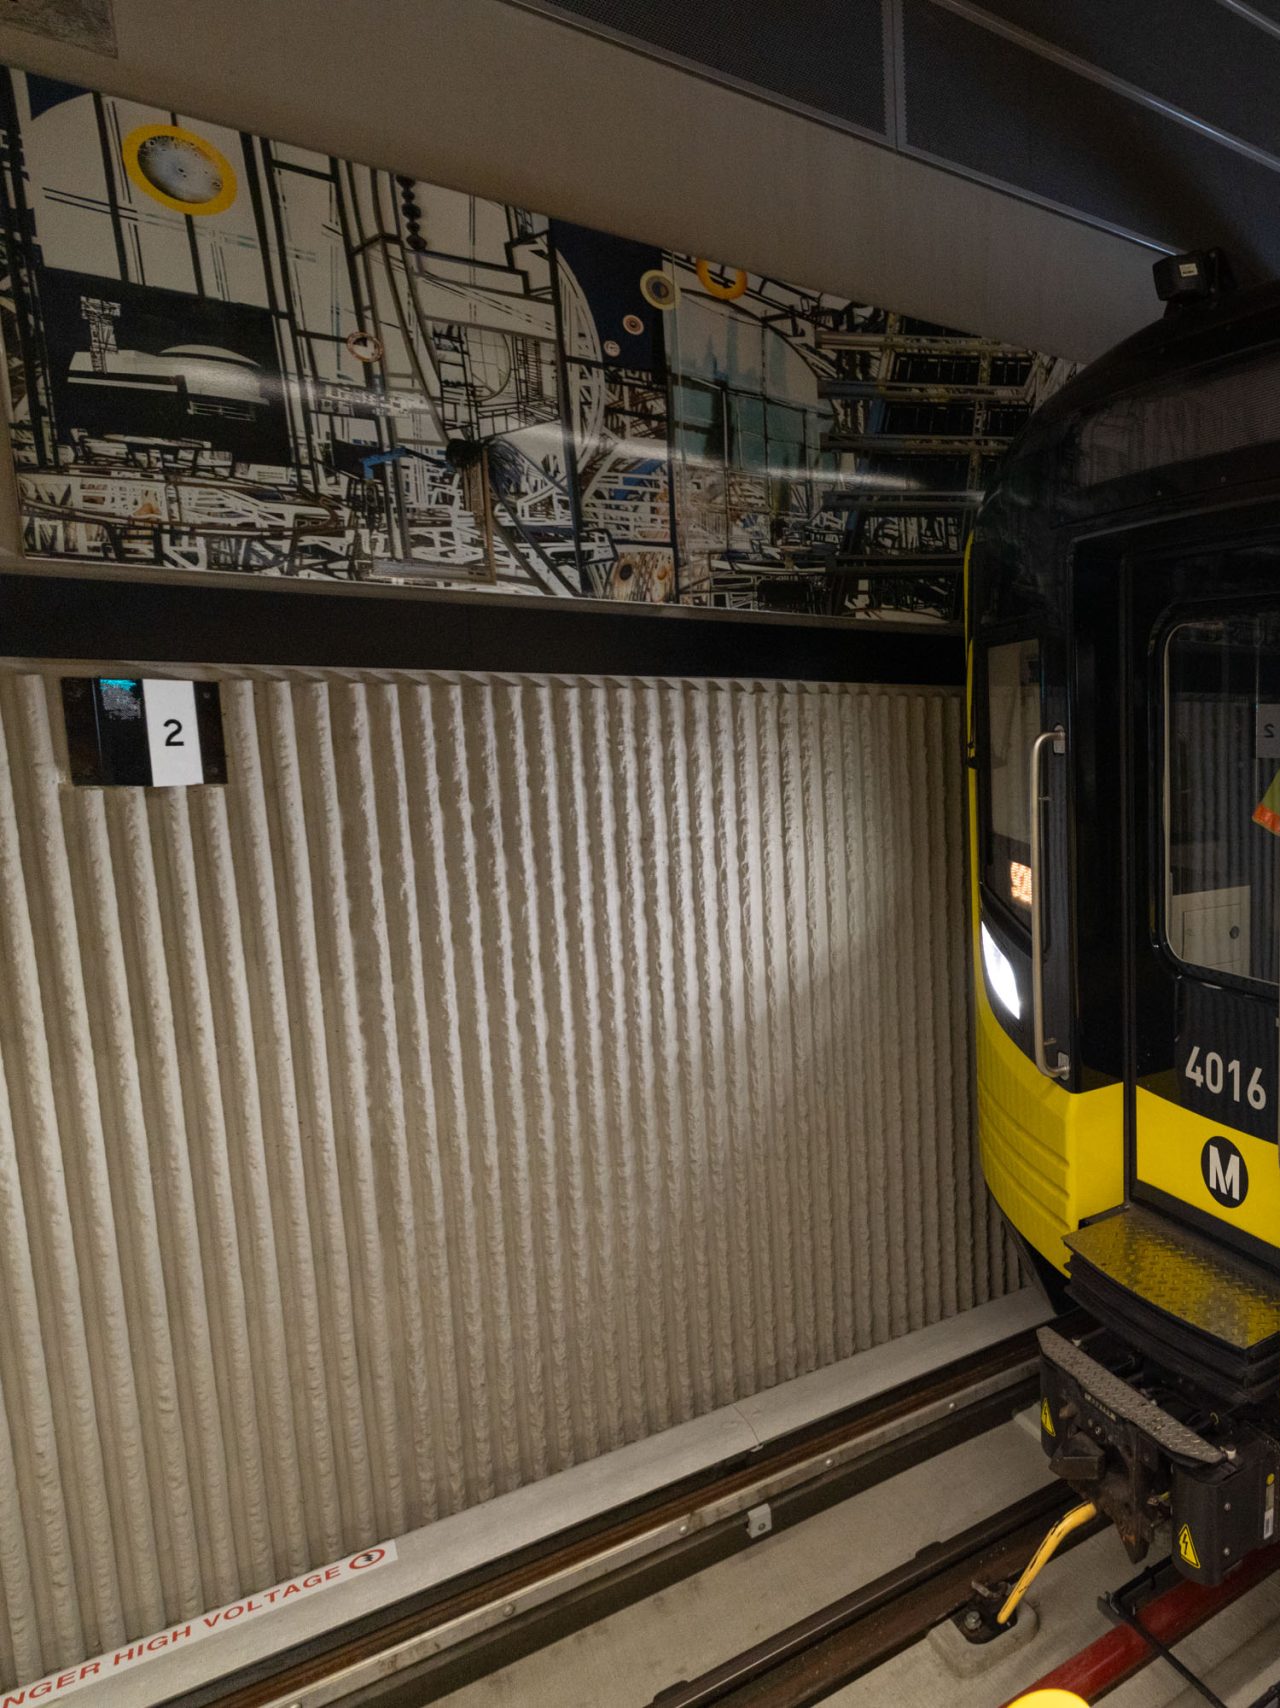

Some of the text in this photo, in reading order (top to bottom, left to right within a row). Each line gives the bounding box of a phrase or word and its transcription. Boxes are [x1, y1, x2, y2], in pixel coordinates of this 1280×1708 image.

[163, 718, 185, 747] 2
[1185, 1045, 1267, 1111] 4016
[1209, 1144, 1240, 1201] M
[3, 1566, 342, 1708] NGER HIGH VOLTAGE
